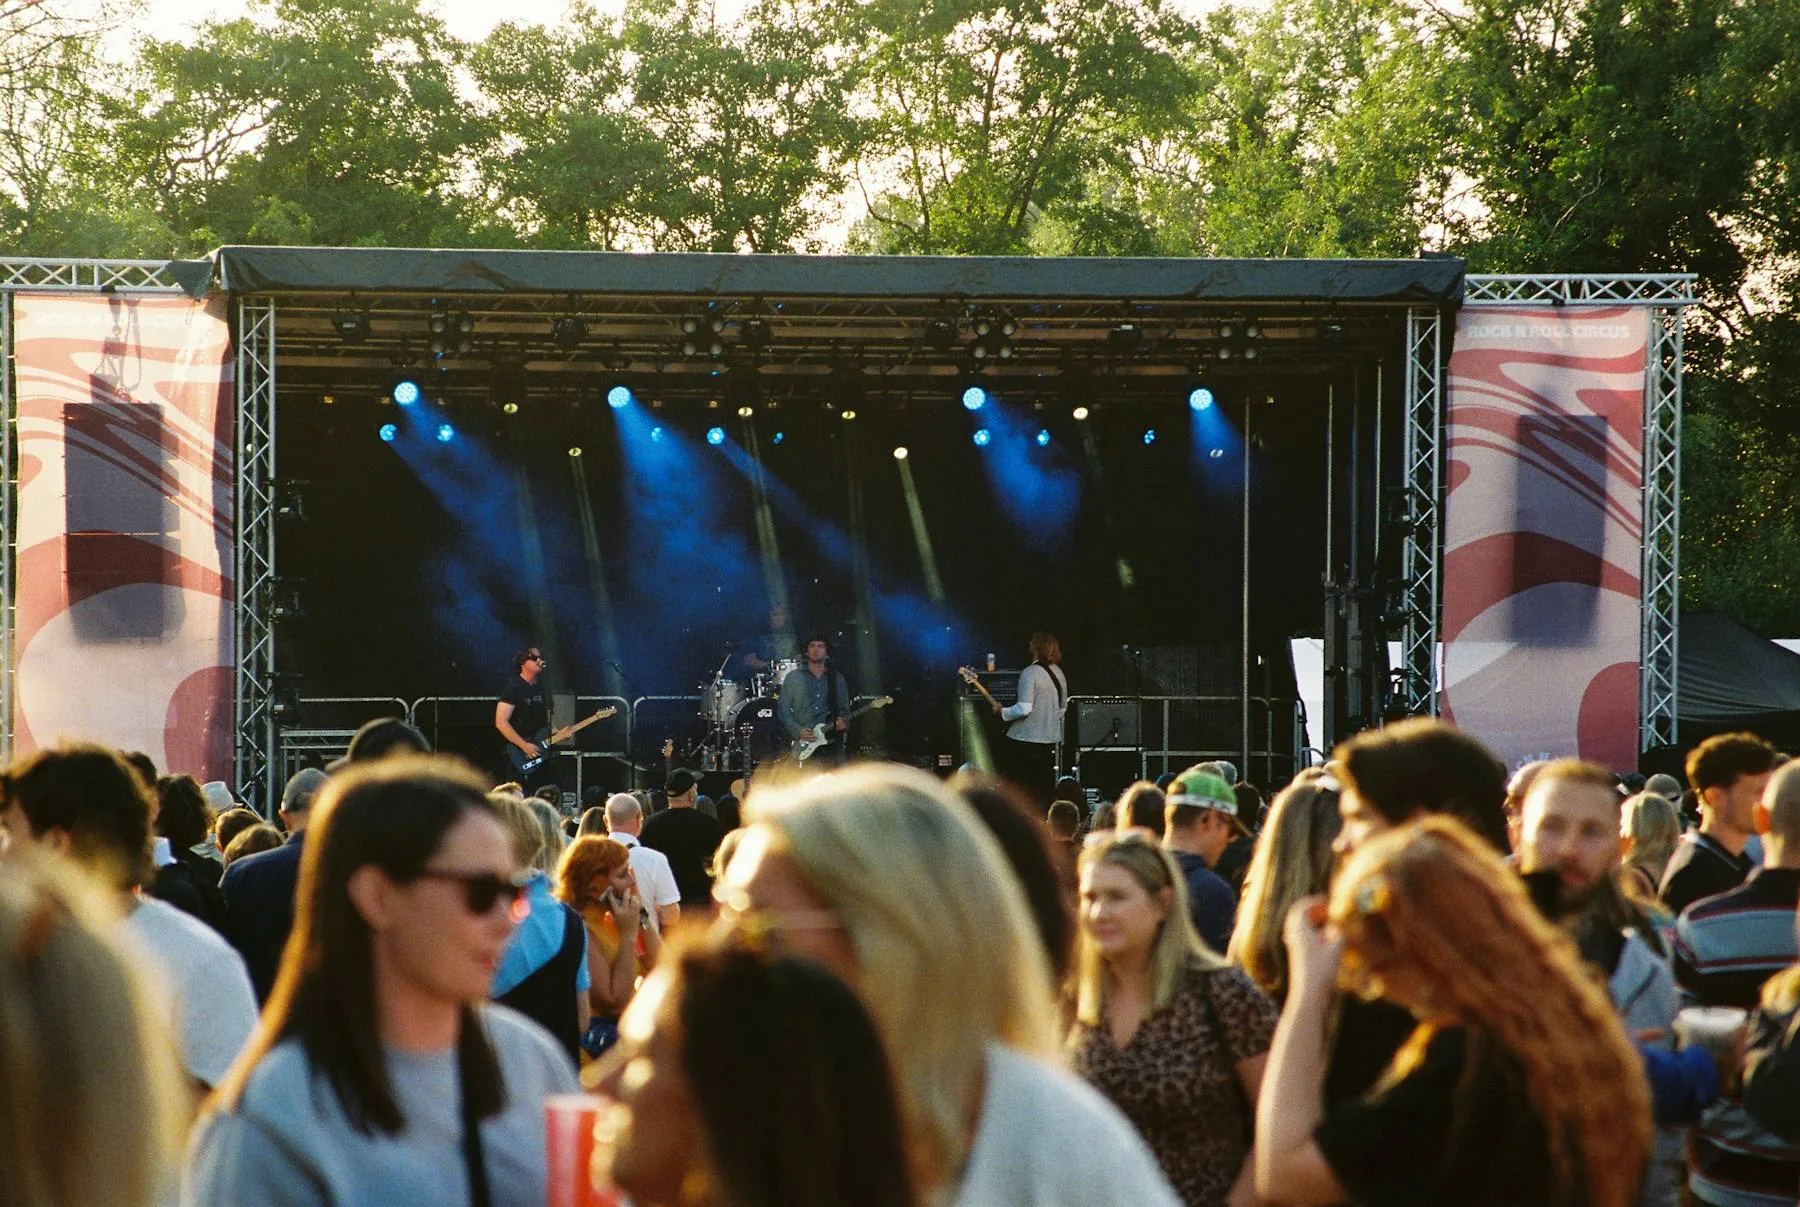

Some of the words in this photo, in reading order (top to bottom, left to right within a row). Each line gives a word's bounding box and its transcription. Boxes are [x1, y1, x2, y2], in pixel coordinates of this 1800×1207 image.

[1467, 325, 1512, 338] ROCK
[1514, 325, 1527, 338] N
[1528, 325, 1570, 338] ROLL
[1572, 325, 1631, 338] CIRCUS
